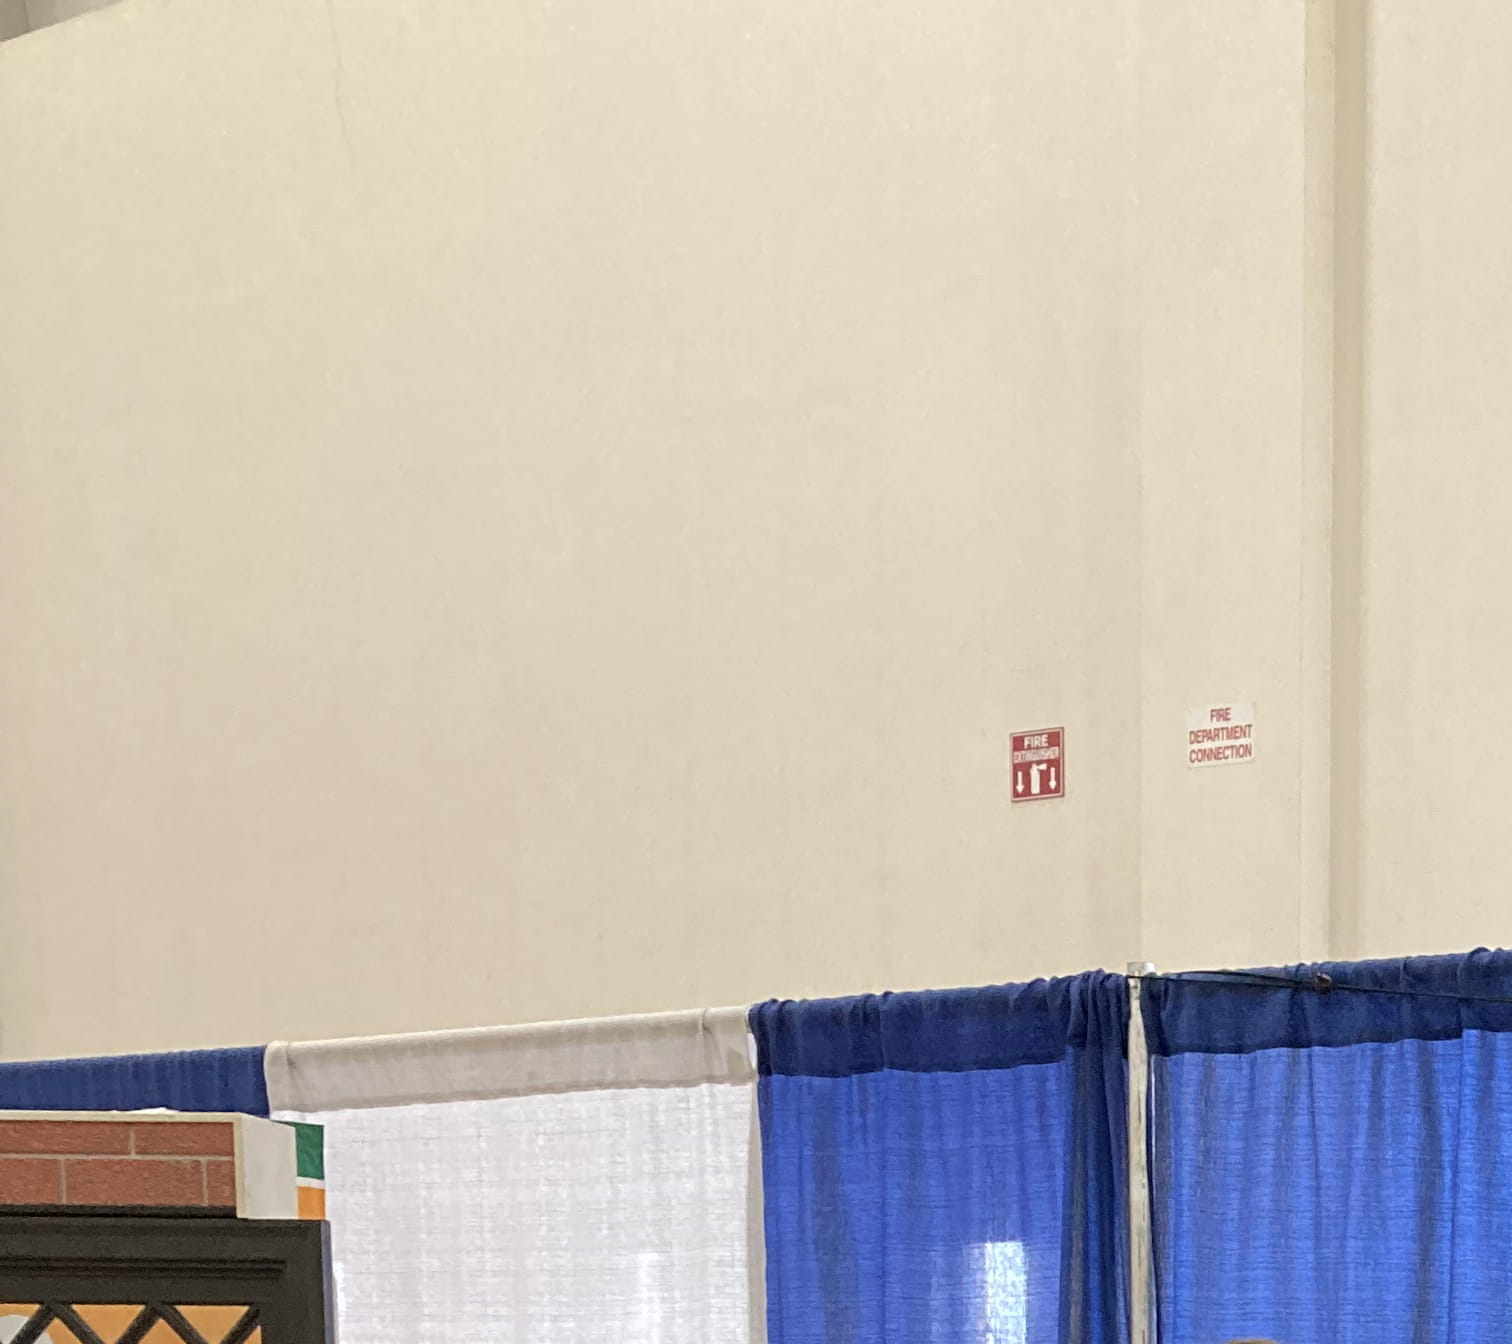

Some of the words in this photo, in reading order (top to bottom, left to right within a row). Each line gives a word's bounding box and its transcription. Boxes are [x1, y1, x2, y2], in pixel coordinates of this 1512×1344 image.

[1209, 707, 1232, 723] FIRE
[1024, 734, 1049, 750] FIRE
[1189, 724, 1253, 745] DEPARTMENT
[1189, 744, 1252, 765] CONNECTION
